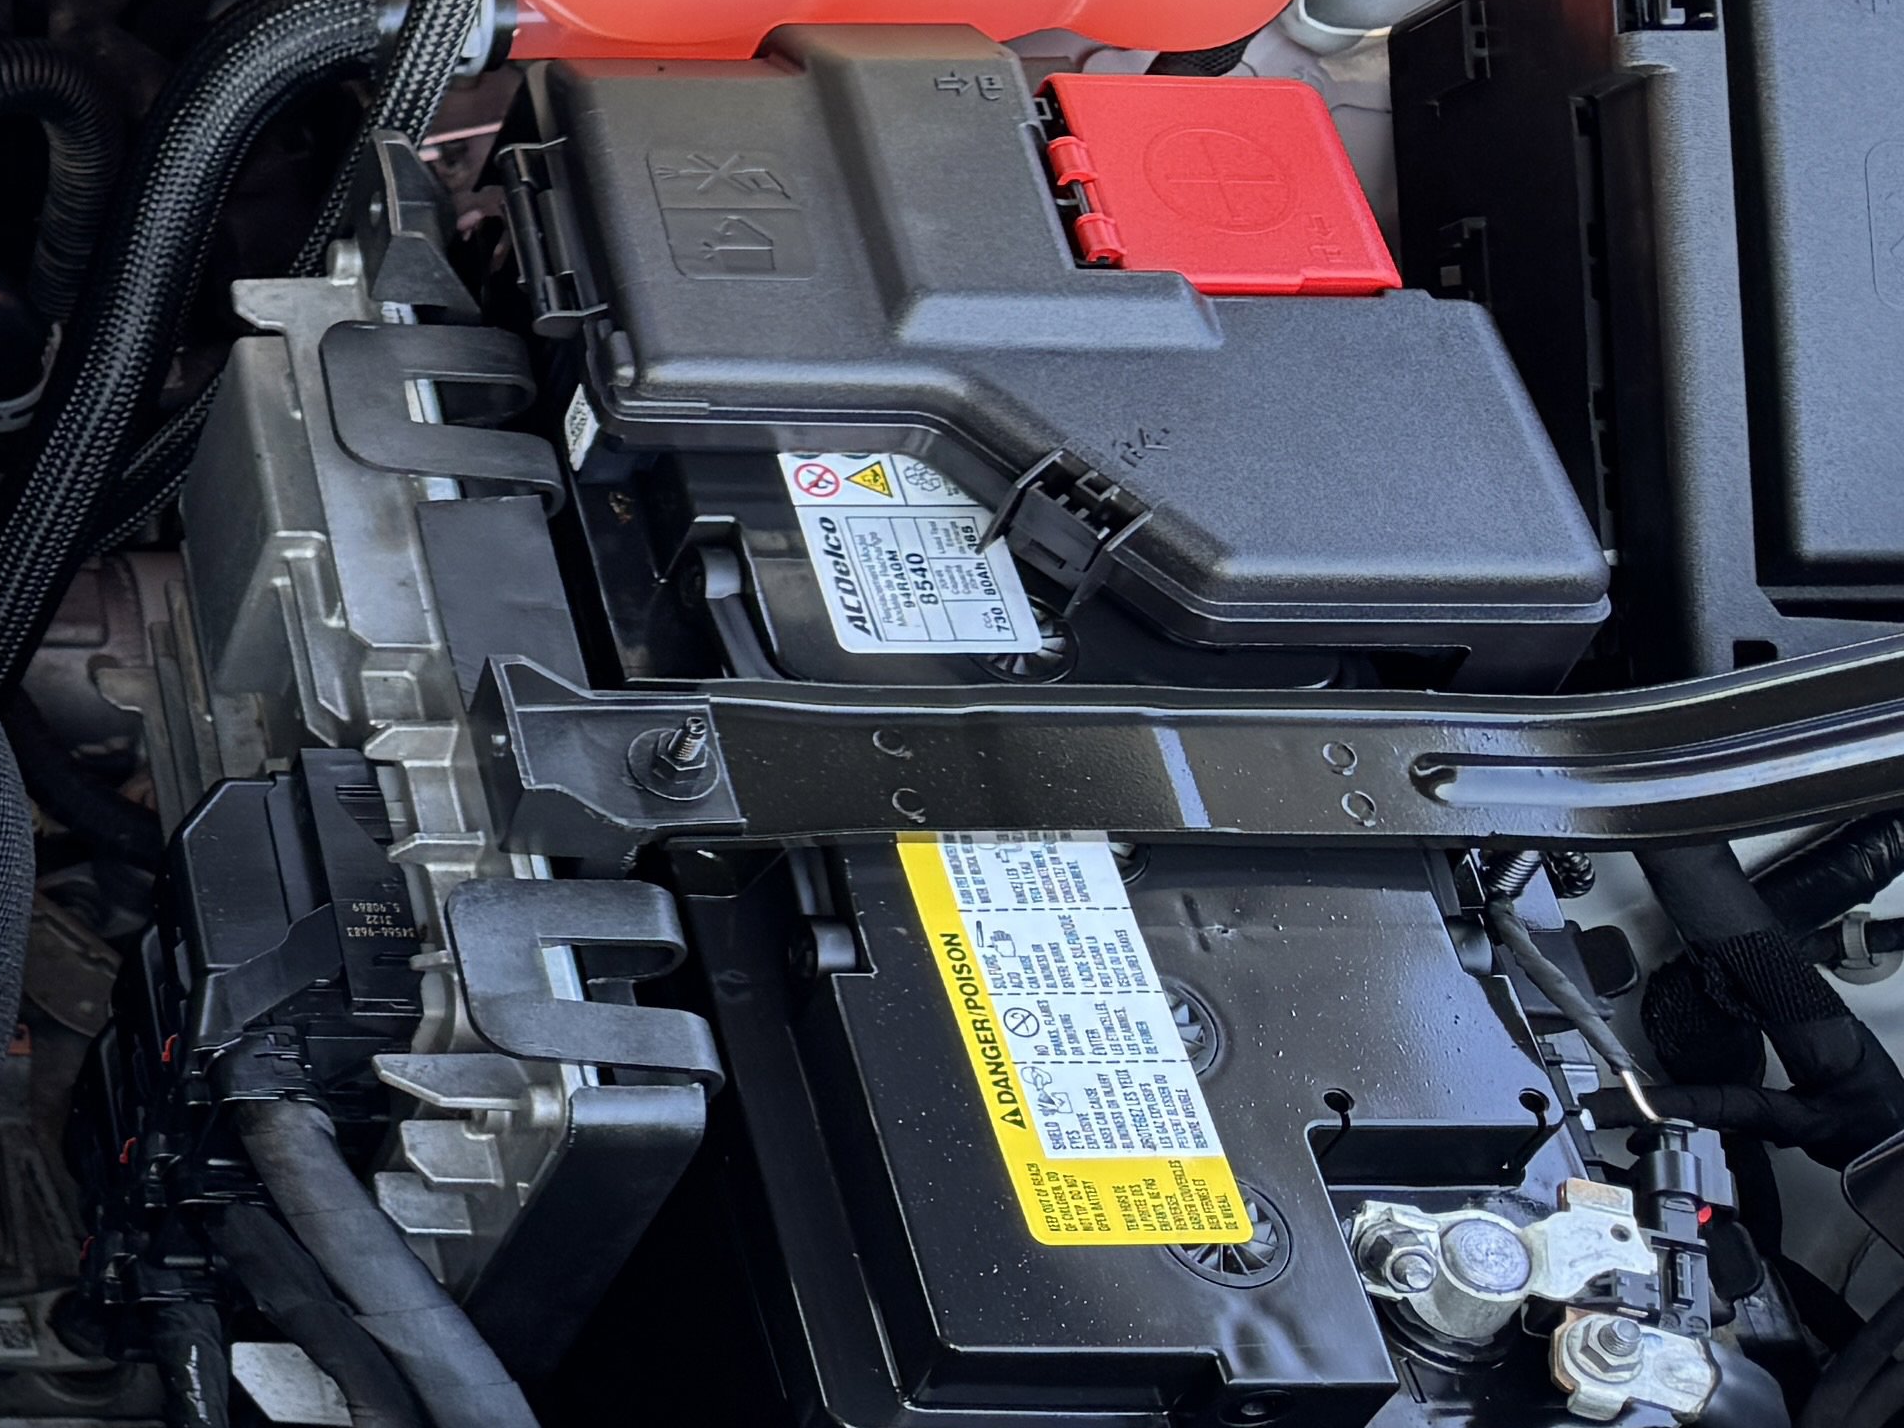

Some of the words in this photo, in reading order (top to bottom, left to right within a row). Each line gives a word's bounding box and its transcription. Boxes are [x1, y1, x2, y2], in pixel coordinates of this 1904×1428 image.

[818, 516, 872, 636] ACDelco
[905, 553, 938, 605] 8540
[974, 562, 996, 595] 80Ah
[991, 607, 1010, 632] 730
[940, 933, 1017, 1104] DANGER/POISON
[1044, 1122, 1067, 1150] SHIELD
[1065, 1130, 1085, 1149] EYES
